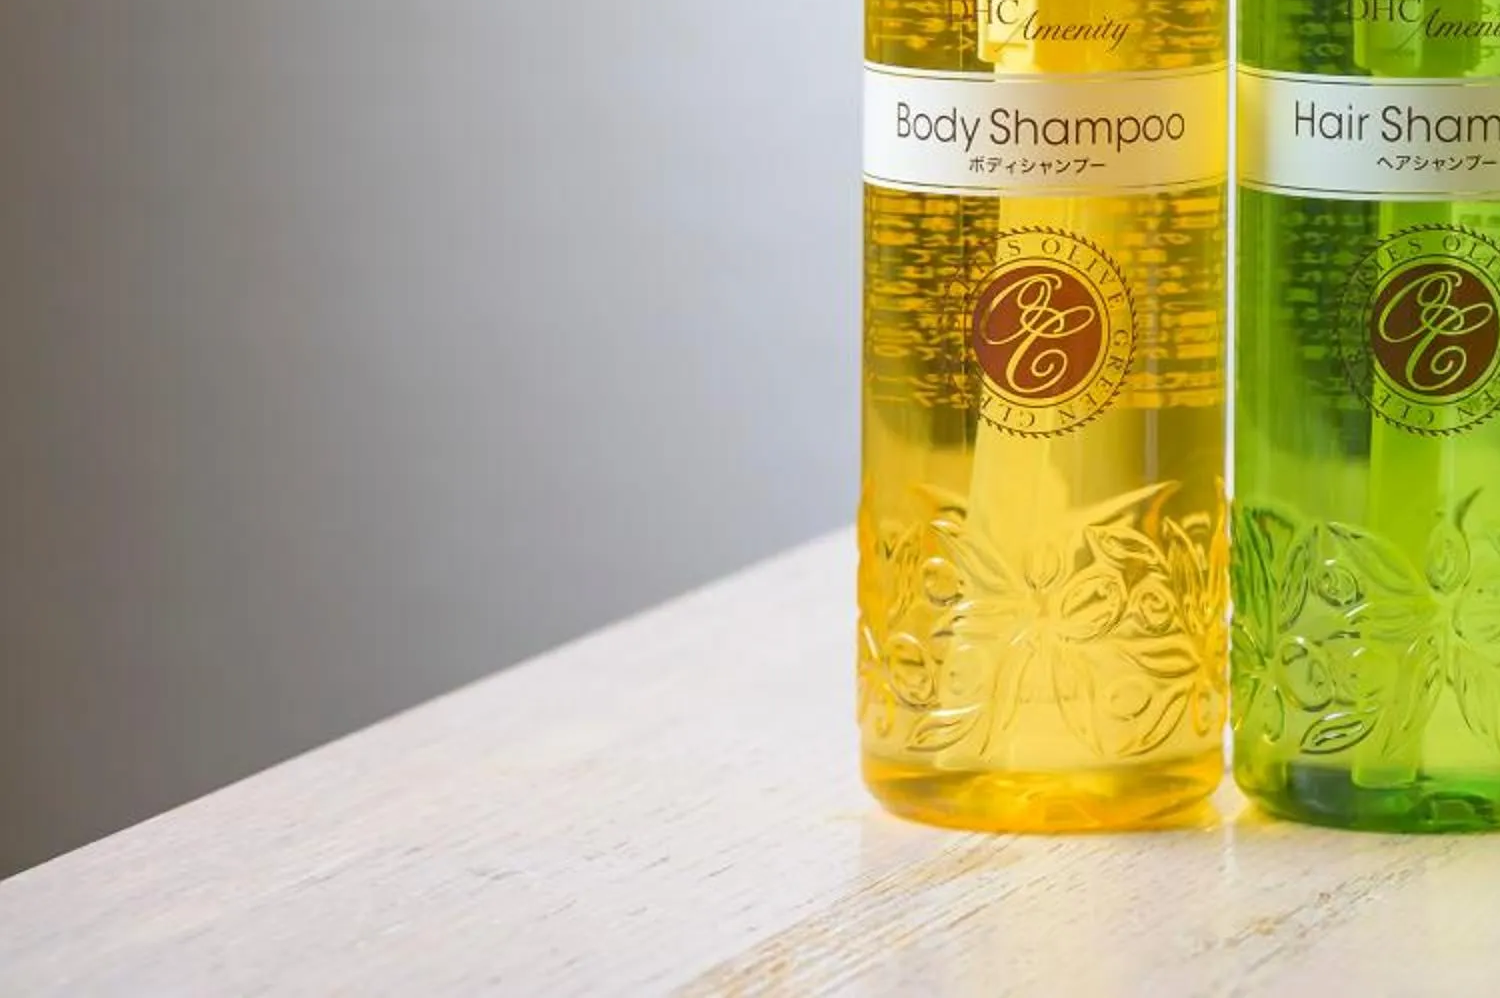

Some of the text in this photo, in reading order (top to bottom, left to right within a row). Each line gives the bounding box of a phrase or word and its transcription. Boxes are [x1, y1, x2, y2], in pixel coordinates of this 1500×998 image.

[994, 9, 1130, 53] Amenity
[896, 102, 1186, 153] Body Shampoo
[1294, 100, 1370, 140] Hair
[969, 156, 1106, 174] ボディシャンプー
[1376, 155, 1497, 172] ヘアシャンプー
[1041, 239, 1124, 308] OLIVE
[1058, 328, 1129, 421] GREEN
